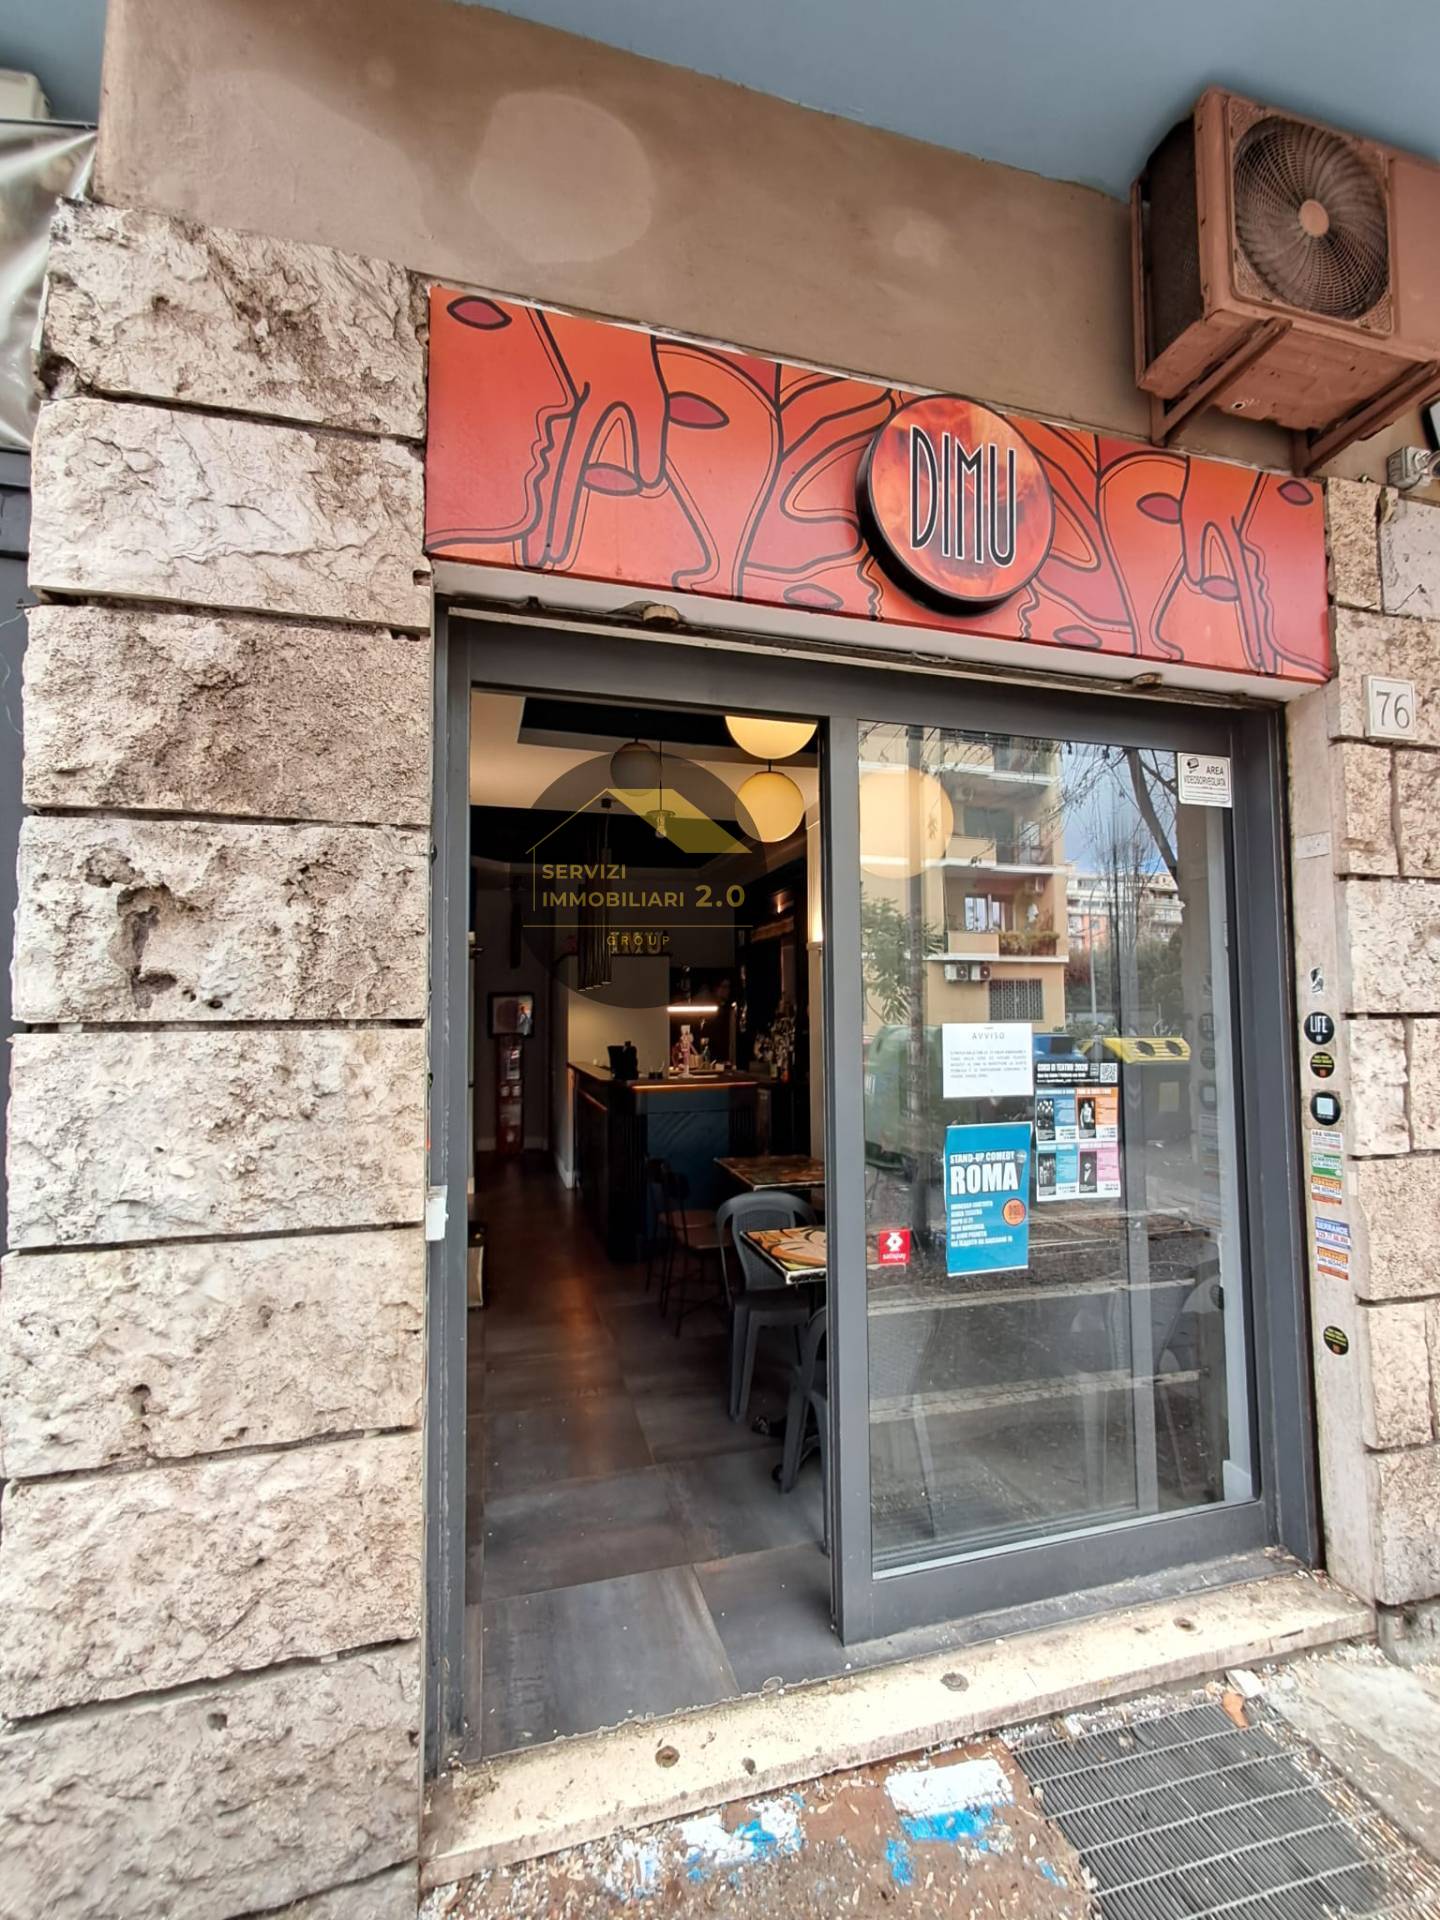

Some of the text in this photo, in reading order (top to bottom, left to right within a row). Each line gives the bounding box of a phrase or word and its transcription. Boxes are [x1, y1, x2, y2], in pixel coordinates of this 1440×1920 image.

[910, 424, 1016, 567] DIMU
[1375, 690, 1410, 729] 76
[1206, 765, 1224, 775] AREA
[972, 1032, 1005, 1041] AVVISO
[950, 1150, 1016, 1164] STAND-UP COMEDY
[950, 1162, 1019, 1196] ROMA
